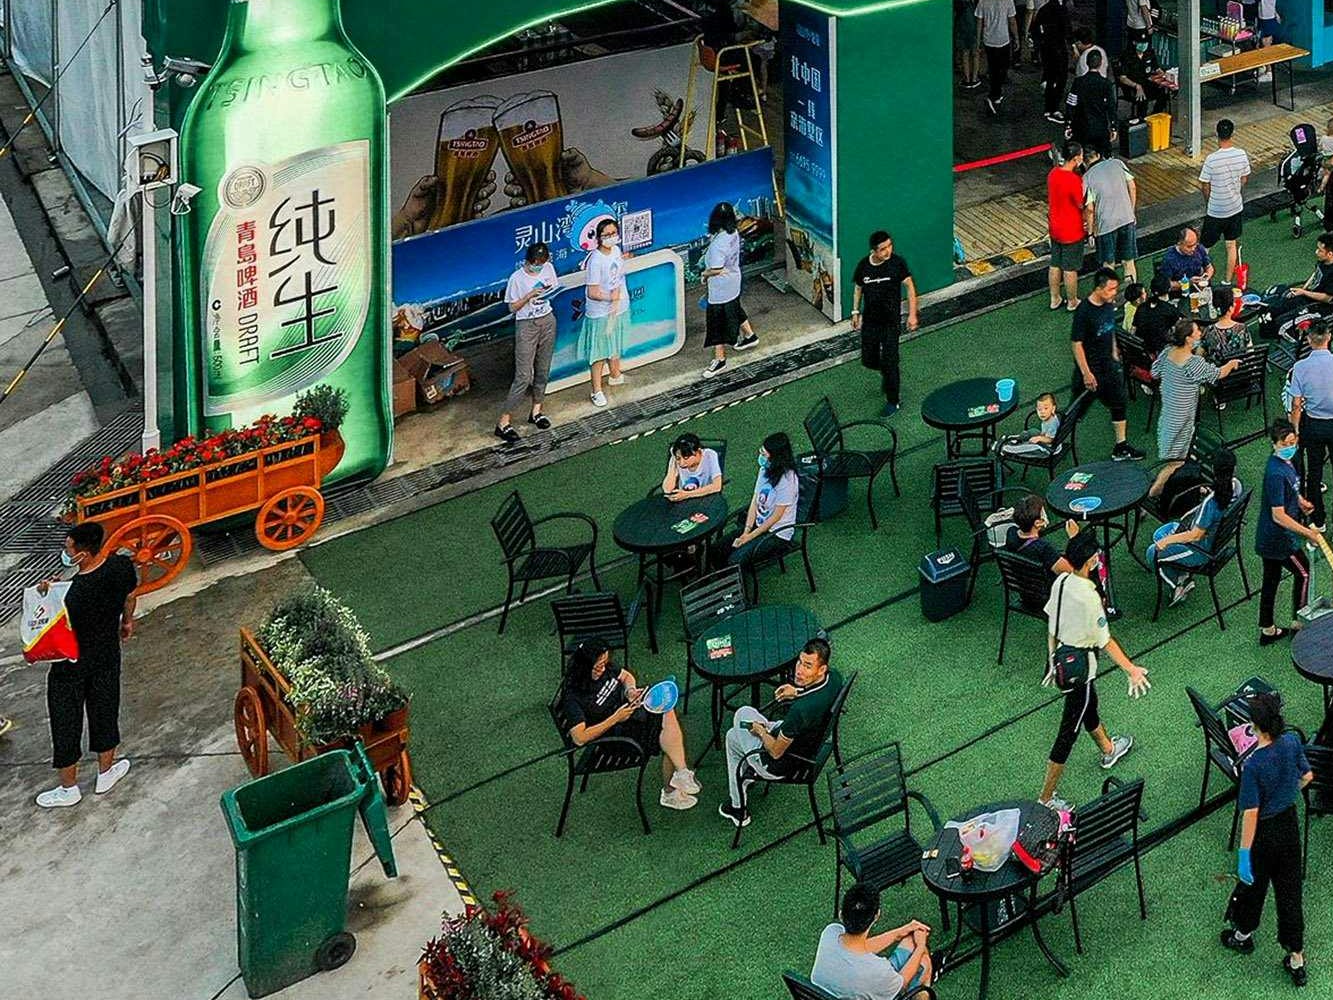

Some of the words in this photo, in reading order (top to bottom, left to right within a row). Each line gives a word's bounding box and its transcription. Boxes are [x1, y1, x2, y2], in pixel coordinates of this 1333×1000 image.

[791, 55, 821, 92] 北中国
[268, 190, 344, 359] 纯生
[237, 311, 260, 366] DRAFT
